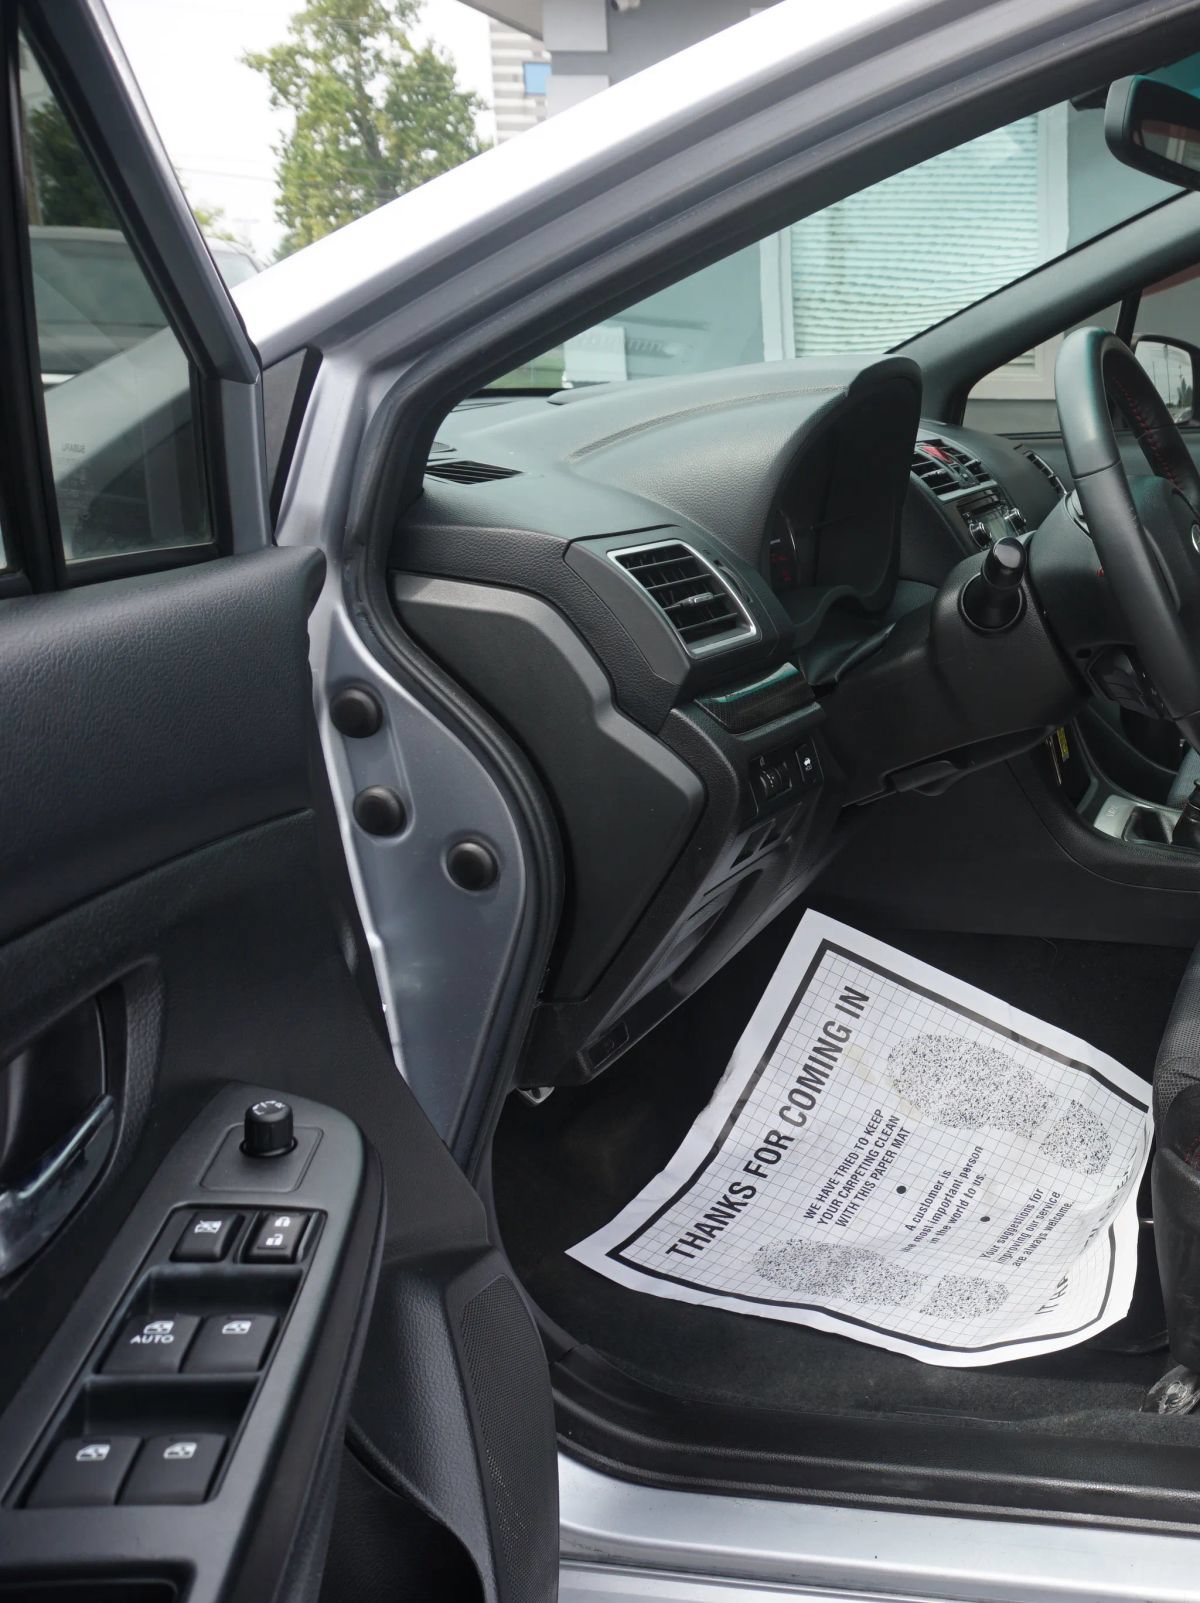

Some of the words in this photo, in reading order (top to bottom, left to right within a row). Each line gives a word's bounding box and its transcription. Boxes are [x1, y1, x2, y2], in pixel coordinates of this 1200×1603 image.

[665, 1181, 757, 1259] THANKS
[743, 1129, 795, 1179] FOR
[778, 1020, 852, 1128] COMING
[834, 985, 870, 1020] IN
[803, 1202, 821, 1219] WE
[815, 1177, 840, 1203] HAVE
[834, 1152, 859, 1177] TRIED
[853, 1137, 869, 1151] TO
[863, 1108, 884, 1136] KEEP
[817, 1199, 843, 1225] YOUR
[838, 1149, 880, 1199] CARPETING
[874, 1114, 900, 1149] CLEAN
[834, 1202, 860, 1228] WITH
[853, 1180, 876, 1201] THIS
[870, 1150, 898, 1181] PAPER
[890, 1127, 911, 1149] MAT
[912, 1179, 944, 1224] customer
[939, 1170, 952, 1179] is
[913, 1225, 934, 1243] most
[928, 1179, 963, 1224] important
[959, 1146, 983, 1179] person
[936, 1225, 951, 1237] the
[948, 1199, 969, 1224] world
[963, 1187, 976, 1199] to
[972, 1173, 987, 1187] us.
[980, 1244, 1000, 1258] Your
[996, 1203, 1035, 1244] suggestions
[1028, 1188, 1044, 1203] for
[1012, 1256, 1027, 1267] are
[1023, 1232, 1048, 1256] always
[1043, 1201, 1075, 1232] welcome.
[1026, 1220, 1040, 1232] our
[1036, 1191, 1061, 1220] service
[130, 1334, 174, 1344] AUTO
